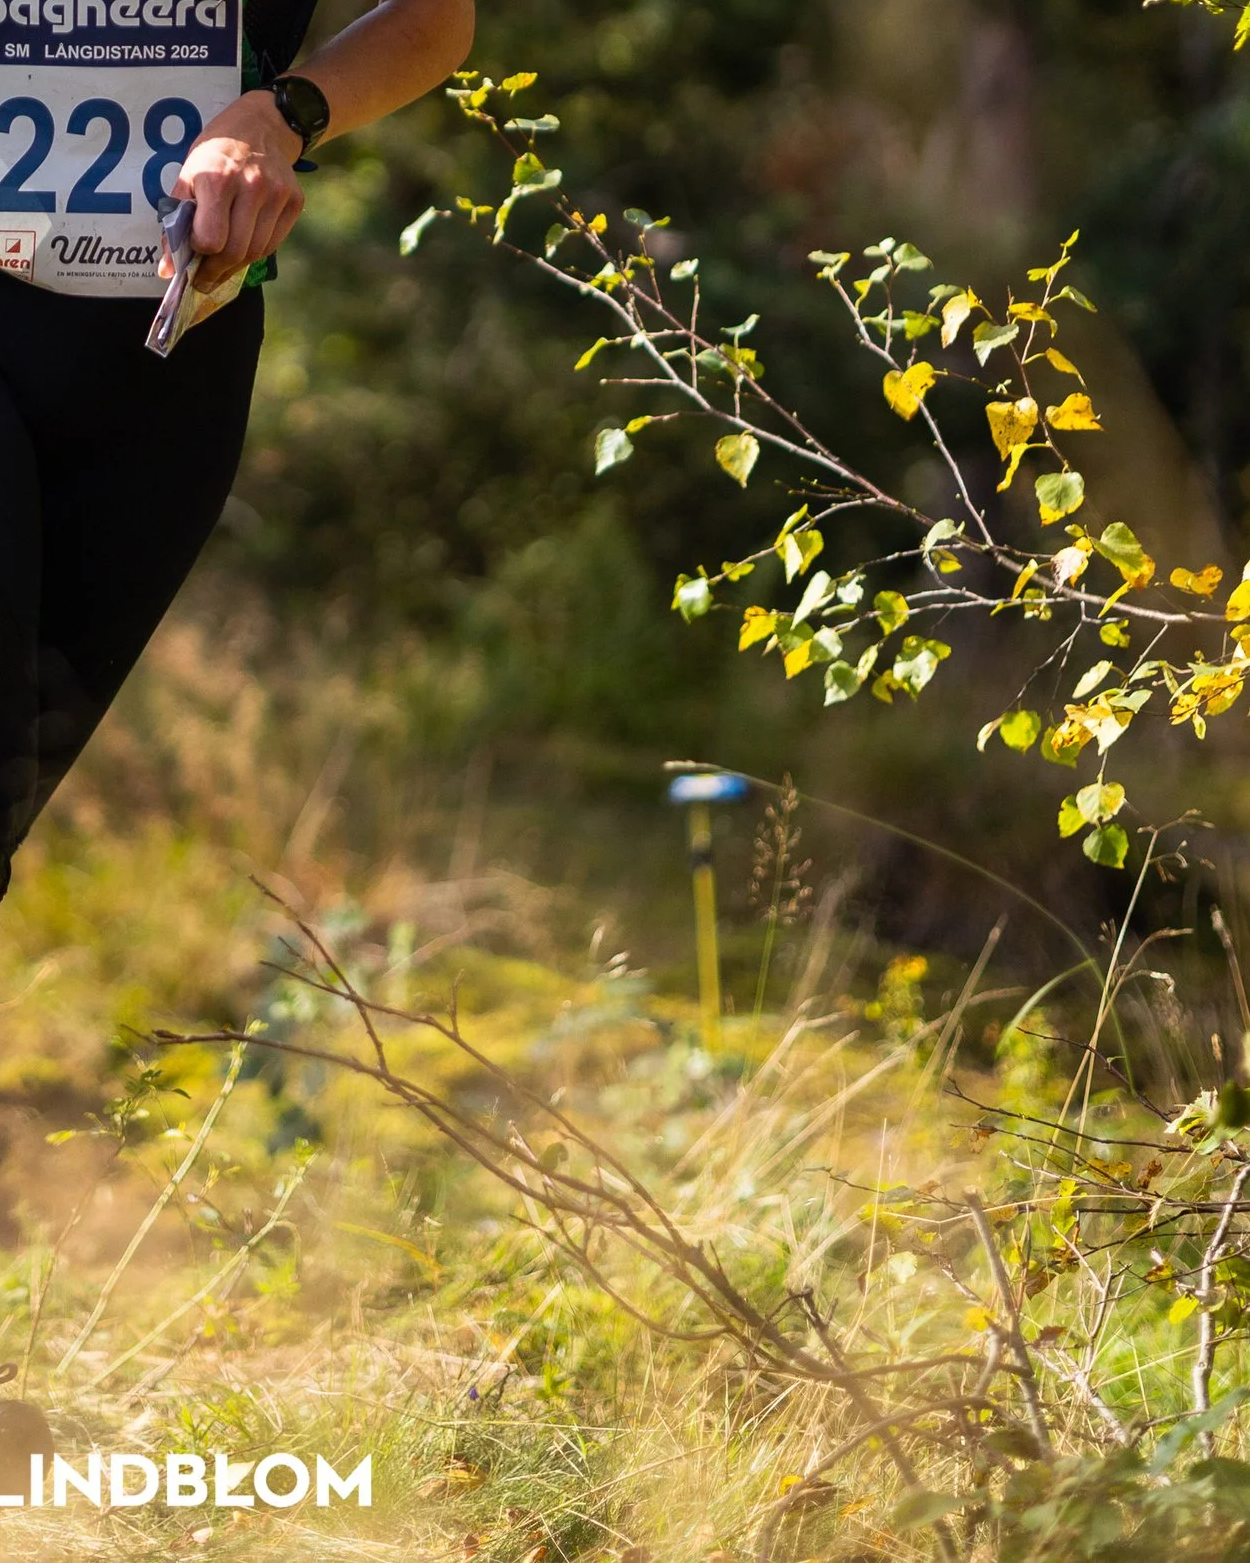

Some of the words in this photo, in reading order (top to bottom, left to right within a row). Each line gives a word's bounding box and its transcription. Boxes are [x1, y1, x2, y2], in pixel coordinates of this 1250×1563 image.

[5, 43, 30, 58] SM
[44, 41, 166, 60] LÅNGDISTANS
[170, 44, 209, 59] 2025
[51, 235, 157, 265] Ullmax
